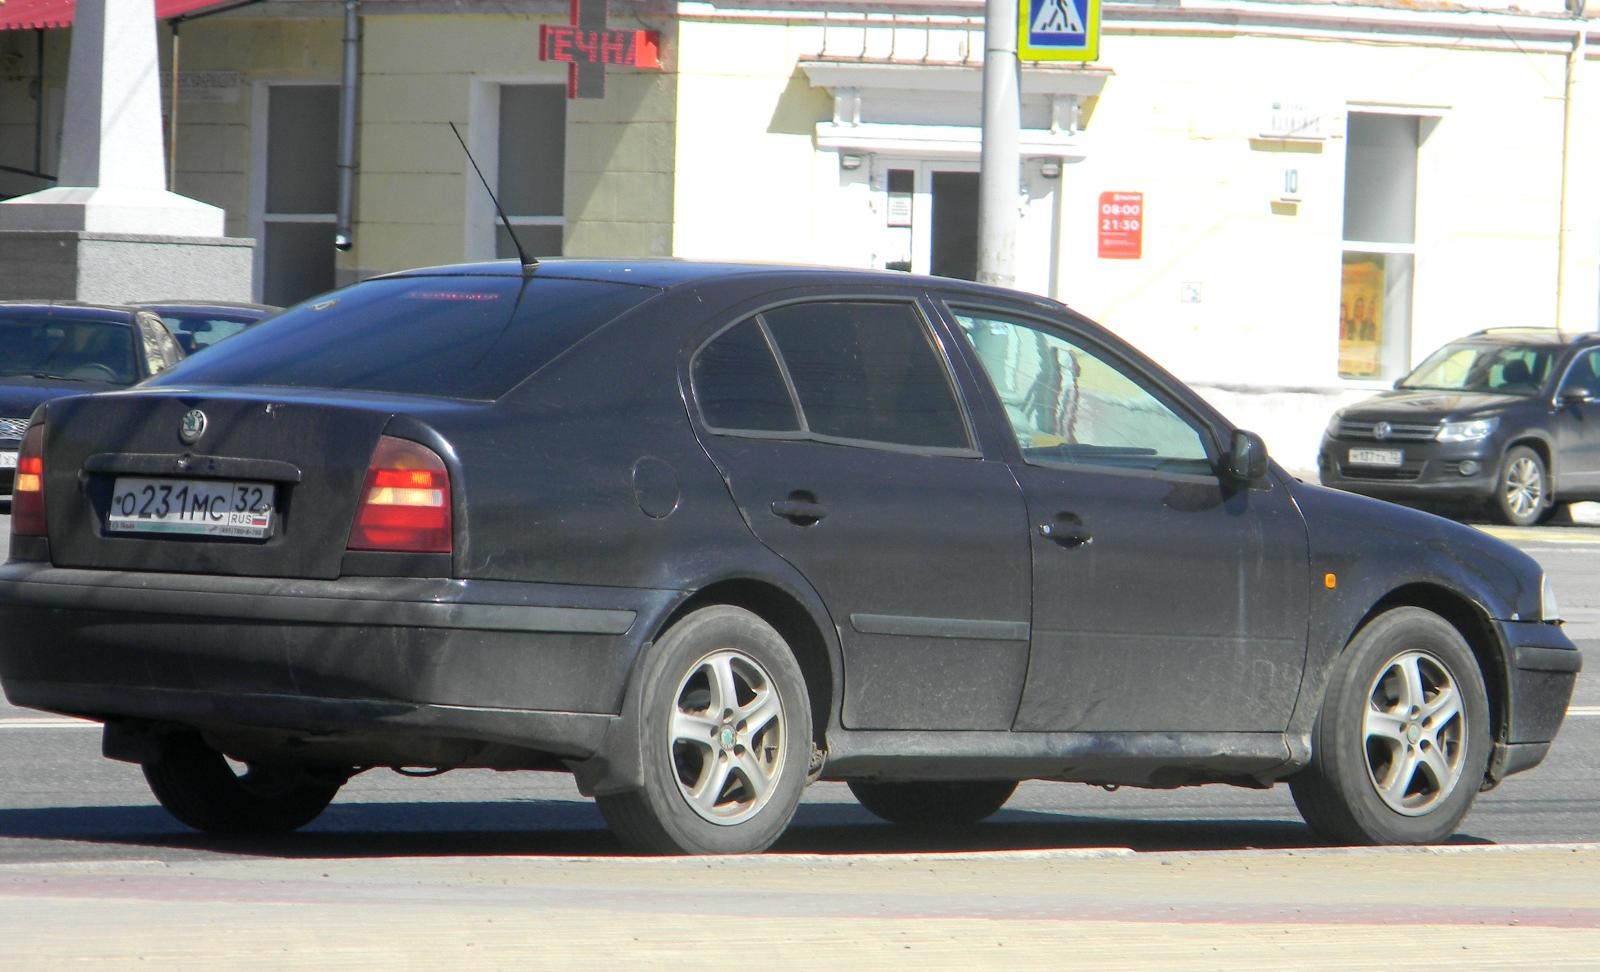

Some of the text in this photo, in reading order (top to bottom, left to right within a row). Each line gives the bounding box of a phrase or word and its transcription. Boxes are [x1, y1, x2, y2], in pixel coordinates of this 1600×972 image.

[1285, 169, 1298, 193] 10
[235, 487, 263, 513] 32
[230, 514, 251, 525] RUS
